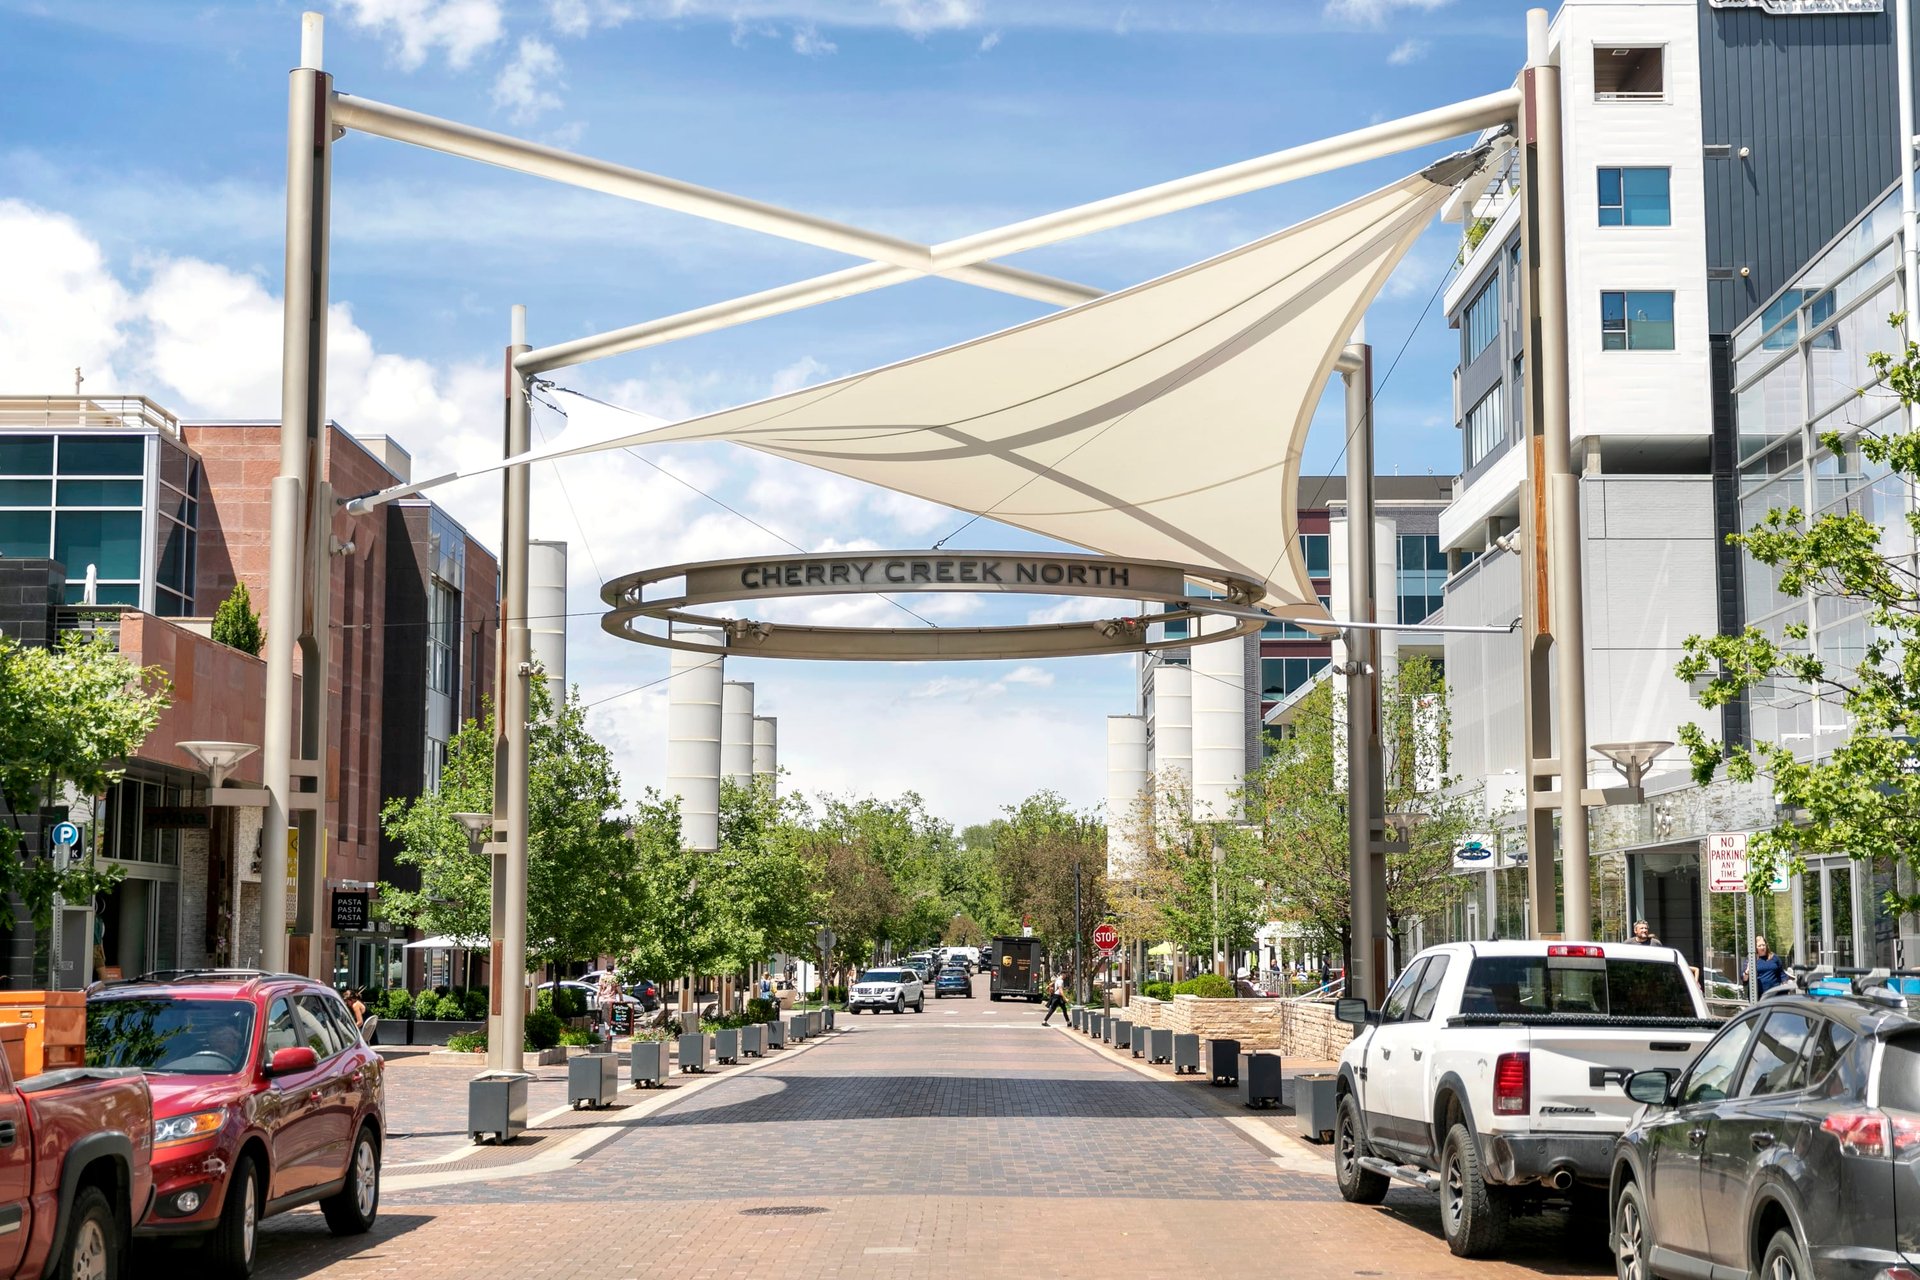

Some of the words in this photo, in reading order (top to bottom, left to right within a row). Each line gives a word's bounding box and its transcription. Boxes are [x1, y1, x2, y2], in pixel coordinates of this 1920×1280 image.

[740, 562, 873, 588] CHERRY
[884, 560, 1002, 583] CREEK
[1016, 562, 1130, 587] NORTH
[60, 827, 72, 843] P
[1720, 837, 1734, 848] NO
[1711, 850, 1745, 861] PARKING
[1721, 870, 1737, 878] TIME
[337, 898, 362, 906] PASTA
[1095, 932, 1117, 942] STOP
[1539, 1105, 1596, 1115] REBEL
